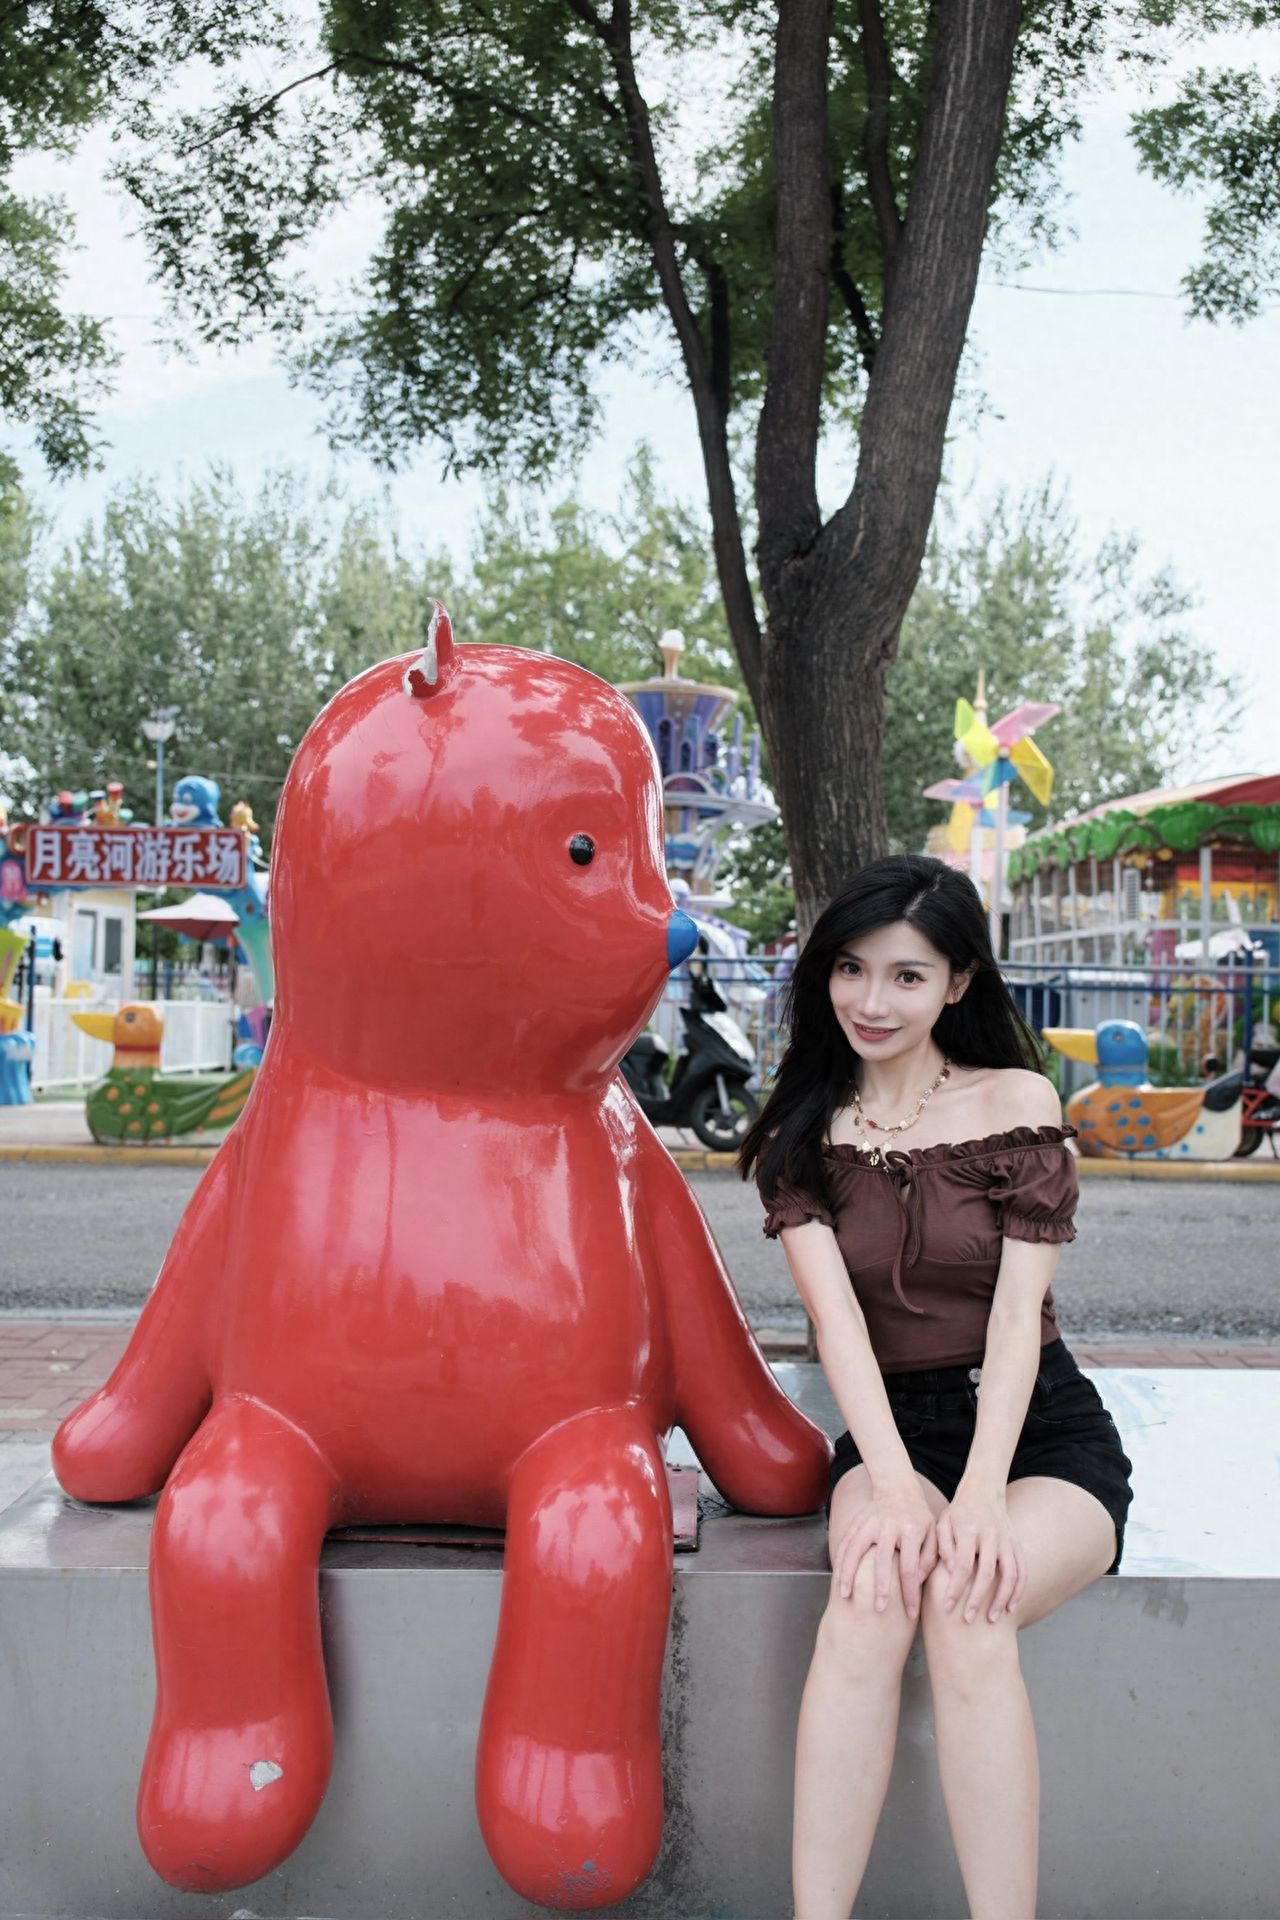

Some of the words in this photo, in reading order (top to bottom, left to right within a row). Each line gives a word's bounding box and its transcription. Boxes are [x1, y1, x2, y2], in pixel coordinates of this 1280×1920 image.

[31, 830, 240, 884] 月亮河游乐场
